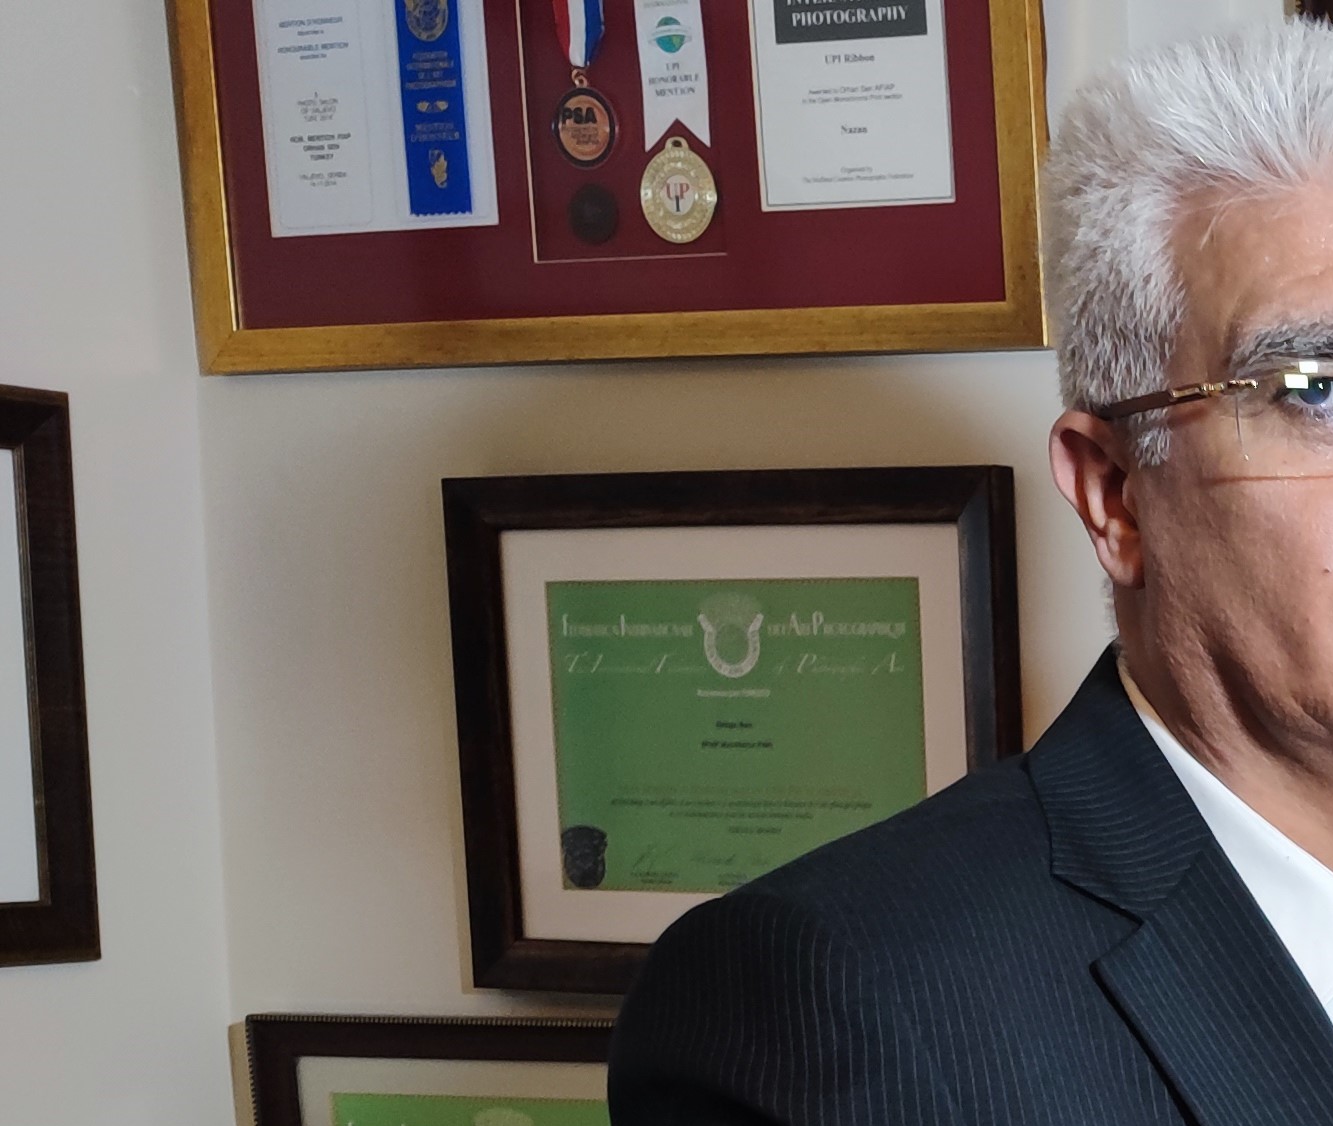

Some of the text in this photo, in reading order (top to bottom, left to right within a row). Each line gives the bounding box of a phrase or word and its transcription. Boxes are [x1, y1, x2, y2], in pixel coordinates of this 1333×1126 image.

[792, 5, 908, 27] PHOTOGRAPHY
[825, 54, 875, 64] UPI Ribbon
[561, 107, 597, 125] PSA
